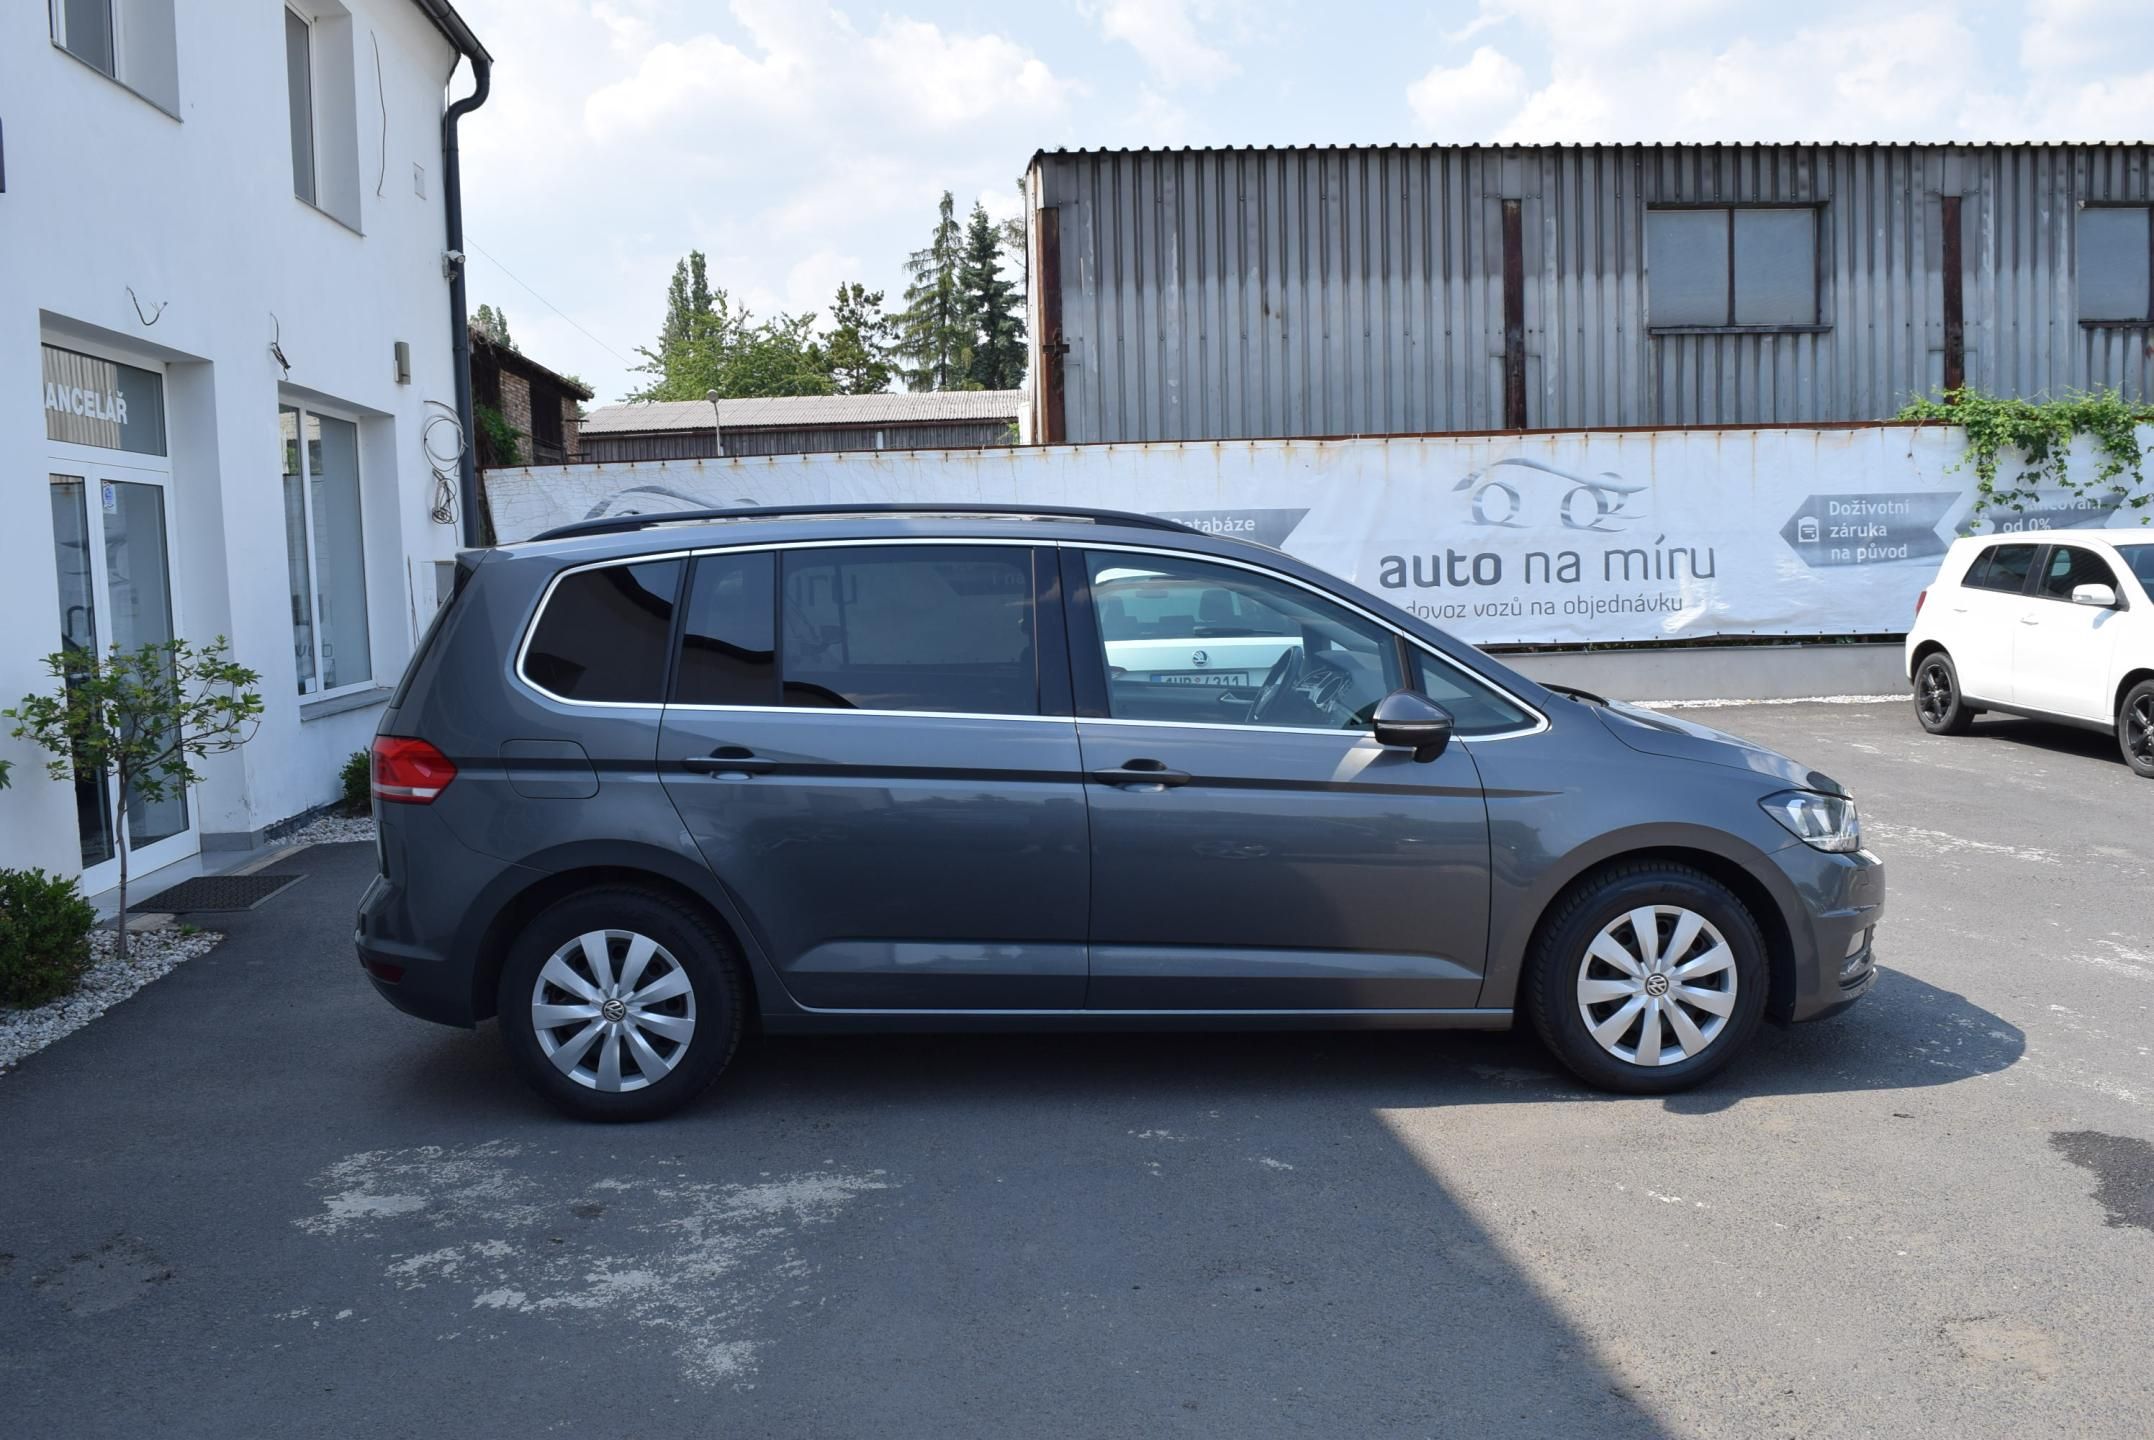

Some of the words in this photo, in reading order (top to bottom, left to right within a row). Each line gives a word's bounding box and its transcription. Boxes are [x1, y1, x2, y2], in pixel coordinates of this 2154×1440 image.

[46, 382, 128, 424] ANCELÁŘ
[1829, 499, 1909, 516] Doživotní
[1829, 522, 1888, 538] záruka
[2003, 518, 2023, 533] od
[2028, 517, 2052, 531] 0%
[1379, 548, 1502, 588] auto
[1524, 550, 1580, 584] na
[1604, 533, 1716, 582] míru
[1831, 547, 1851, 560] na
[1856, 542, 1907, 563] původ
[1473, 596, 1521, 616] vozů
[1531, 599, 1555, 615] na
[1563, 592, 1683, 619] objednávku
